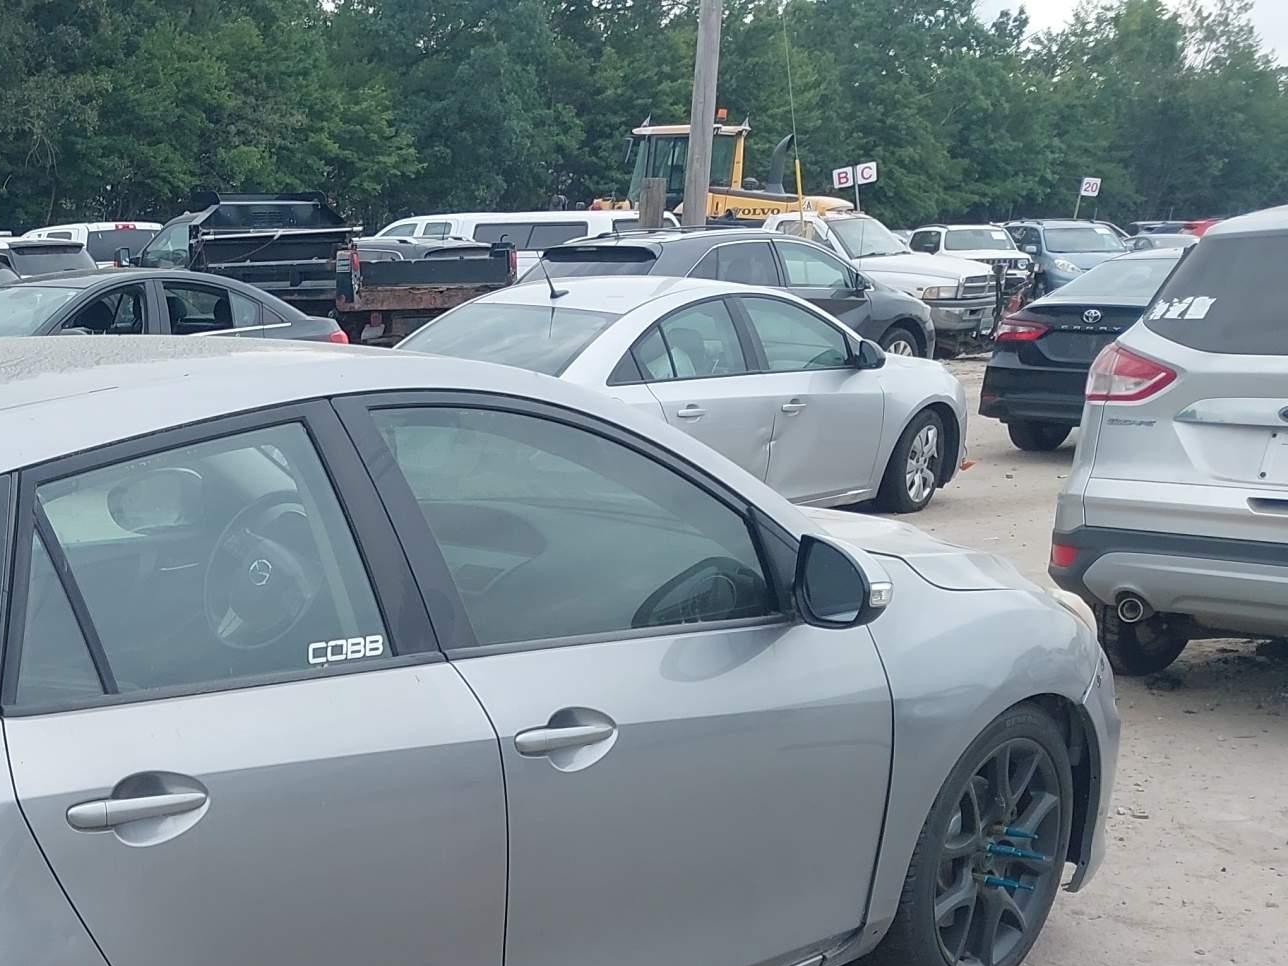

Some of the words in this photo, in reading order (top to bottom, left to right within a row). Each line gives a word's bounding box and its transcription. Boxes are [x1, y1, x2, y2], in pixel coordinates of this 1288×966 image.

[837, 171, 849, 185] B
[861, 166, 873, 180] C
[1084, 181, 1099, 193] 20
[308, 634, 384, 665] COBB
